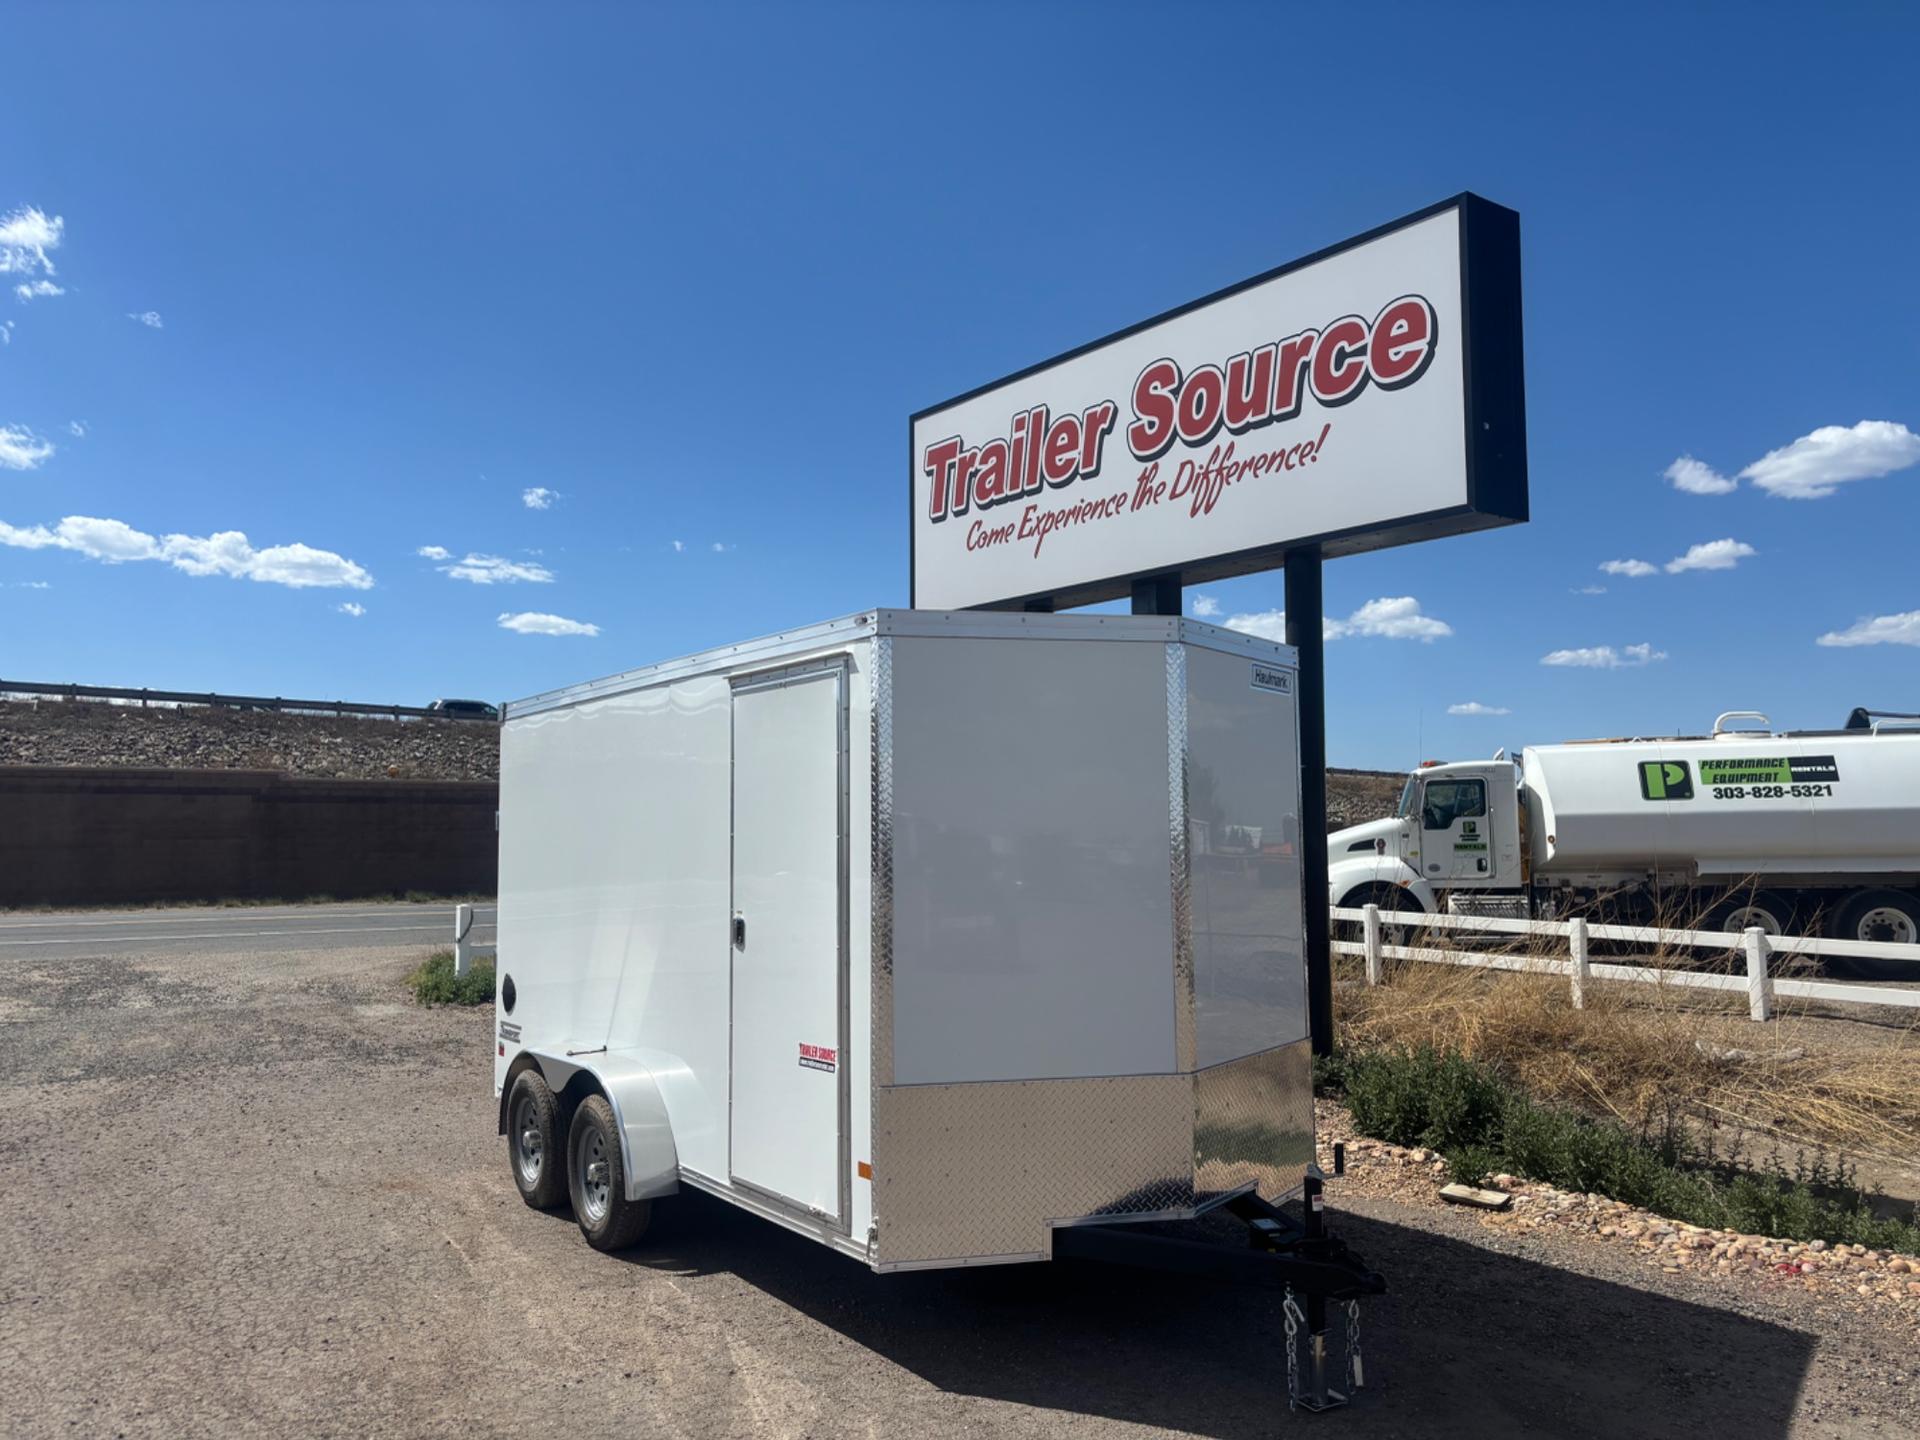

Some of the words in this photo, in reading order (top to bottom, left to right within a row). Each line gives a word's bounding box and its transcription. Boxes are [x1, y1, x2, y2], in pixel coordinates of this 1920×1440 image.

[924, 399, 1117, 522] Trailer
[1127, 294, 1437, 461] Source
[966, 520, 1015, 551] Come
[1018, 491, 1128, 559] Experience
[1130, 462, 1166, 513] the
[1168, 423, 1331, 518] Difference!
[1255, 668, 1288, 689] Haulmark
[1701, 758, 1785, 769] PERFORMANCE
[1712, 772, 1779, 784] EQUIPMENT
[1712, 785, 1832, 799] 303-828-5321
